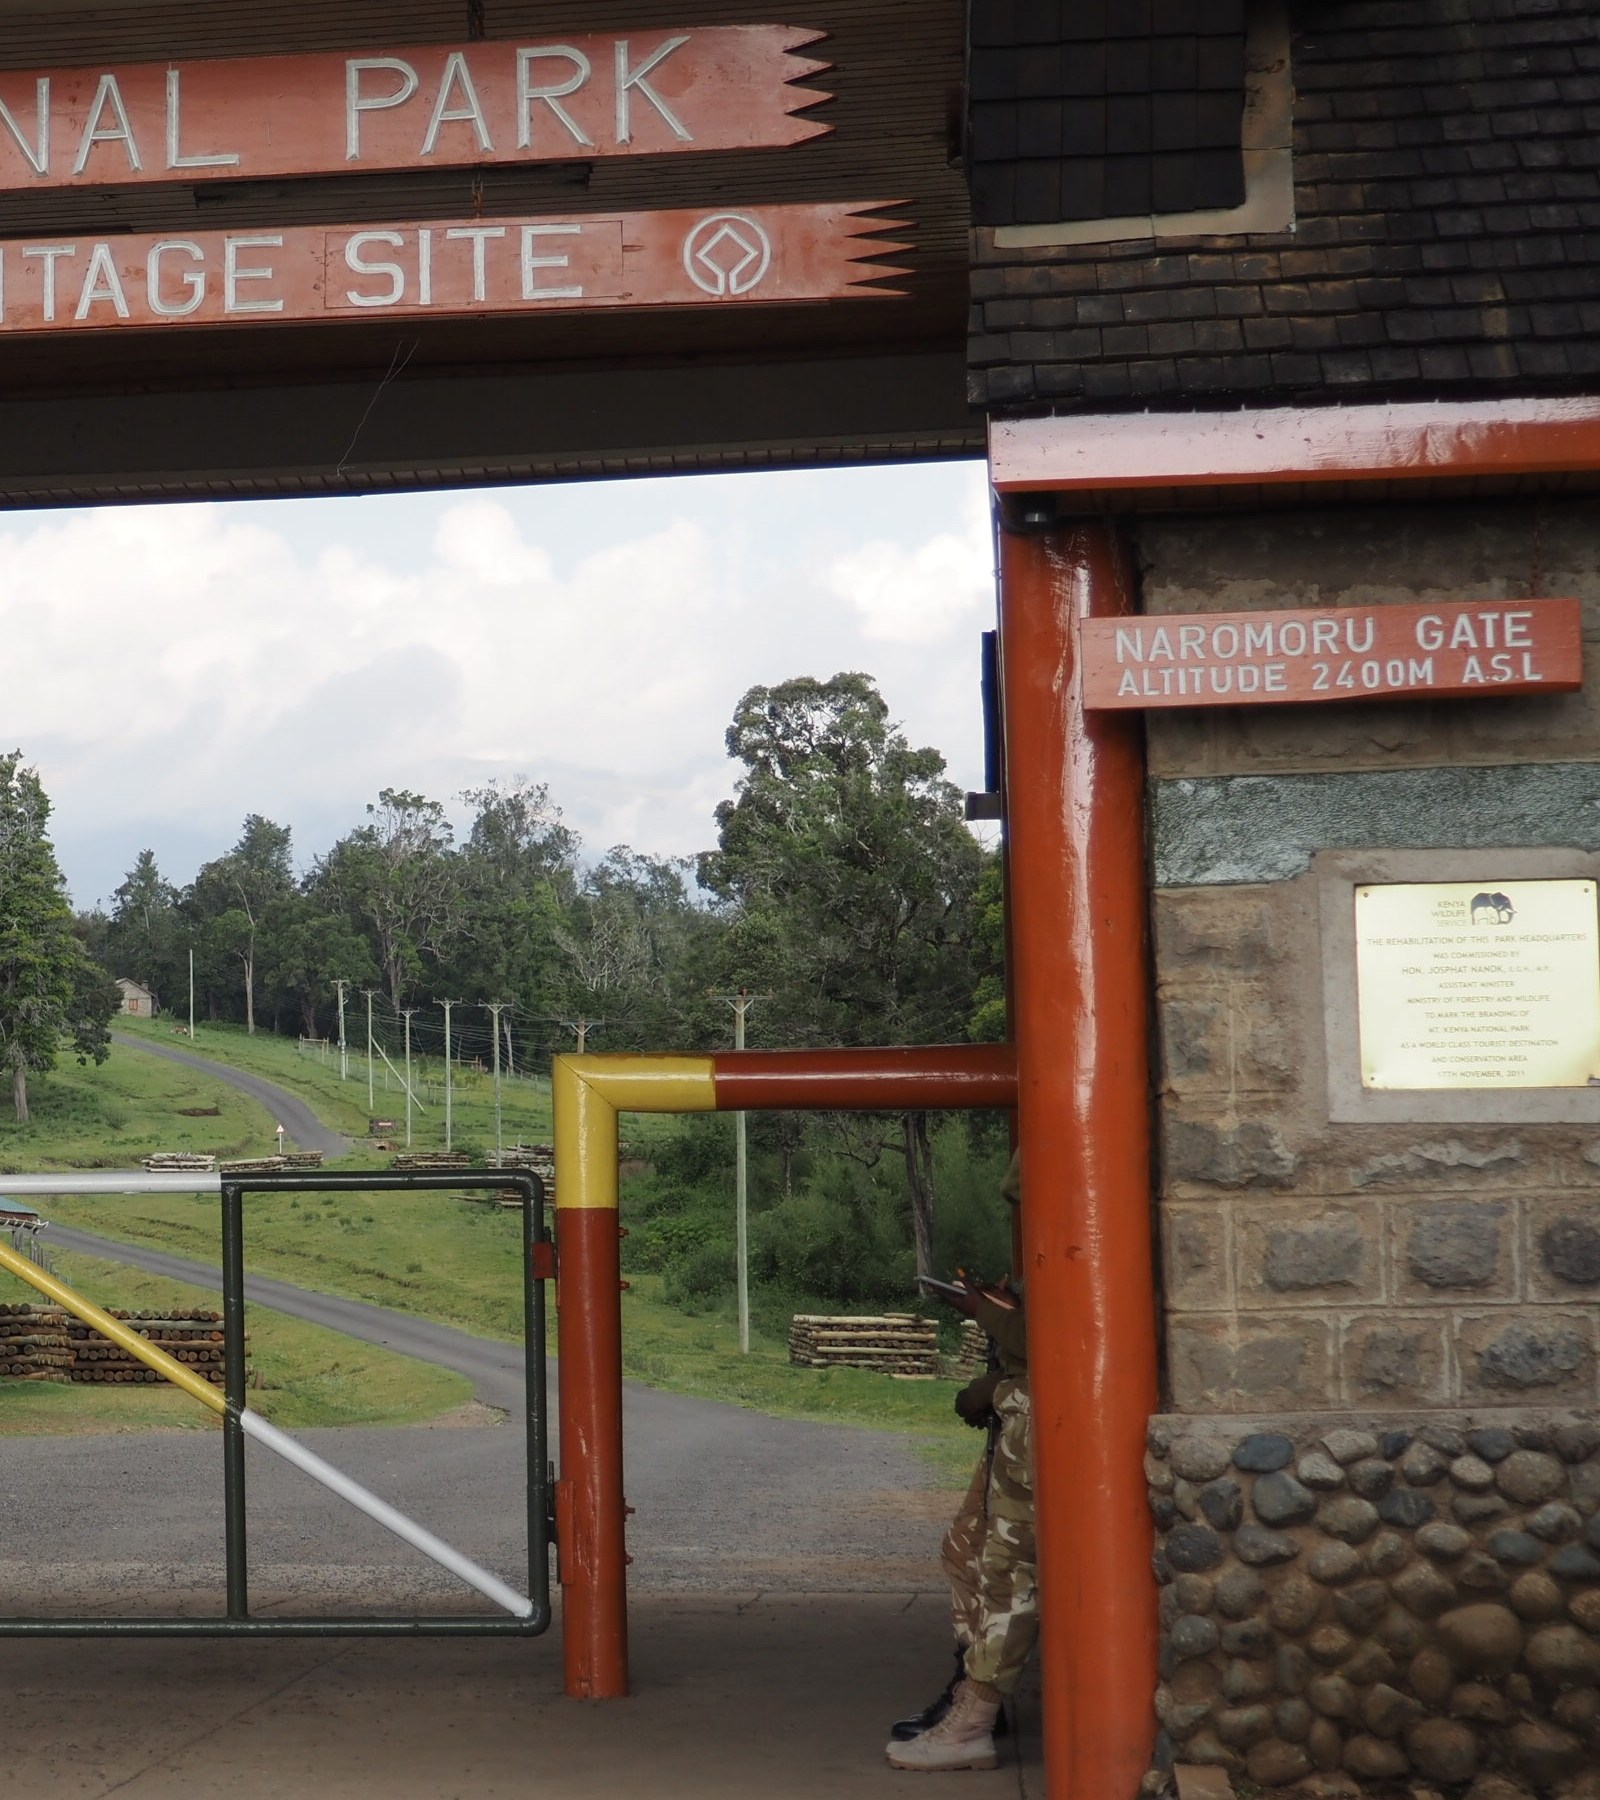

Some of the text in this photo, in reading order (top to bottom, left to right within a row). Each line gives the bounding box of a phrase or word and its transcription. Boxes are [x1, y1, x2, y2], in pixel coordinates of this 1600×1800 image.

[345, 35, 693, 161] PARK
[345, 223, 584, 308] SITE
[1115, 611, 1534, 664] NAROMORU GATE
[1118, 661, 1288, 697] ALTITUDE
[1312, 657, 1434, 691] 2400M
[1431, 909, 1467, 917] WILDLIFE
[1366, 938, 1383, 946] THE
[1386, 937, 1453, 946] REHABILITATION
[1470, 935, 1489, 944] THIS
[1519, 933, 1587, 942] HEADQUARTERS
[1450, 951, 1507, 959] COMMISSIONED
[1427, 966, 1468, 974] JOSPHAT
[1439, 981, 1478, 989] ASSISTANT
[1478, 1010, 1518, 1018] BRANDING
